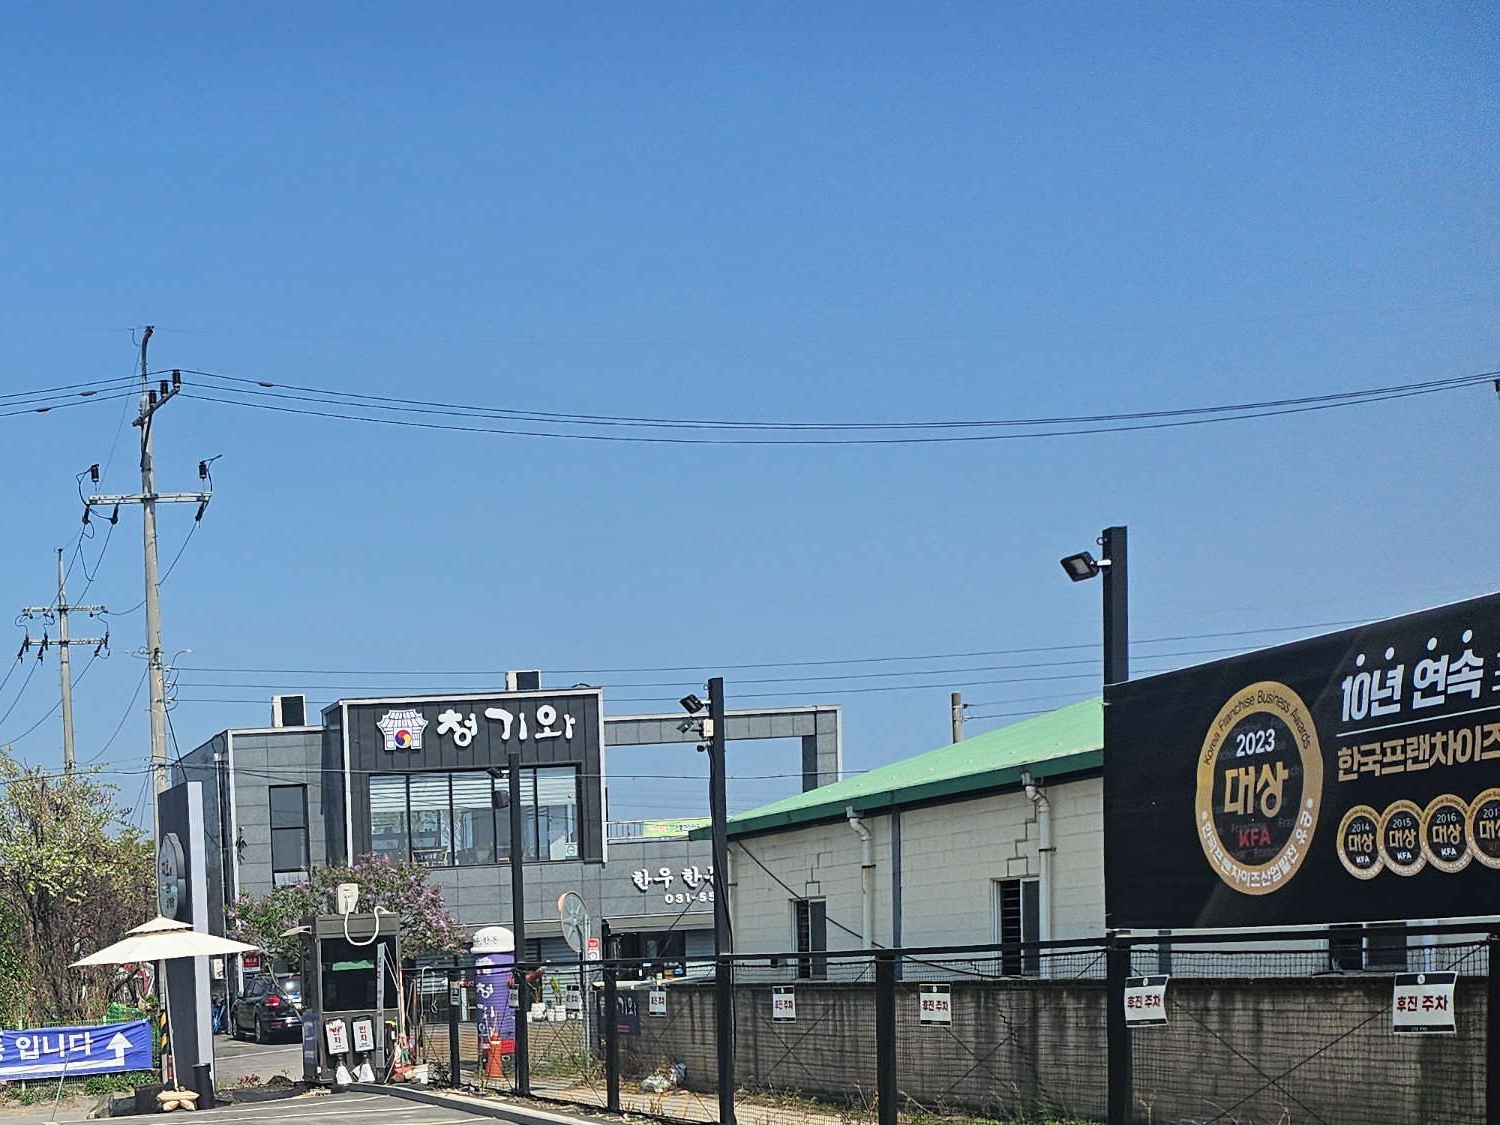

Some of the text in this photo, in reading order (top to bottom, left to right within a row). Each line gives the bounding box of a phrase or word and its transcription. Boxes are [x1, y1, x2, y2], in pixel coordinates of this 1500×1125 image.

[1341, 664, 1405, 722] 10년
[1412, 649, 1484, 709] 연속
[436, 704, 576, 747] 청기와
[1235, 728, 1276, 758] 2023
[1224, 761, 1289, 818] 대상
[1351, 822, 1370, 833] 2014
[1392, 817, 1412, 829] 2015
[1436, 812, 1457, 824] 2016
[1238, 827, 1272, 848] KFA
[1348, 833, 1375, 853] 대상
[1388, 828, 1417, 850] 대상
[1431, 823, 1462, 845] 대상
[1355, 855, 1371, 865] KFA
[1396, 851, 1412, 861] KFA
[1440, 847, 1457, 857] KFA
[922, 1000, 949, 1012] 후진 주차
[1127, 993, 1161, 1009] 후진 주차
[1396, 994, 1448, 1012] 후진 주차
[15, 1031, 94, 1061] 입니다
